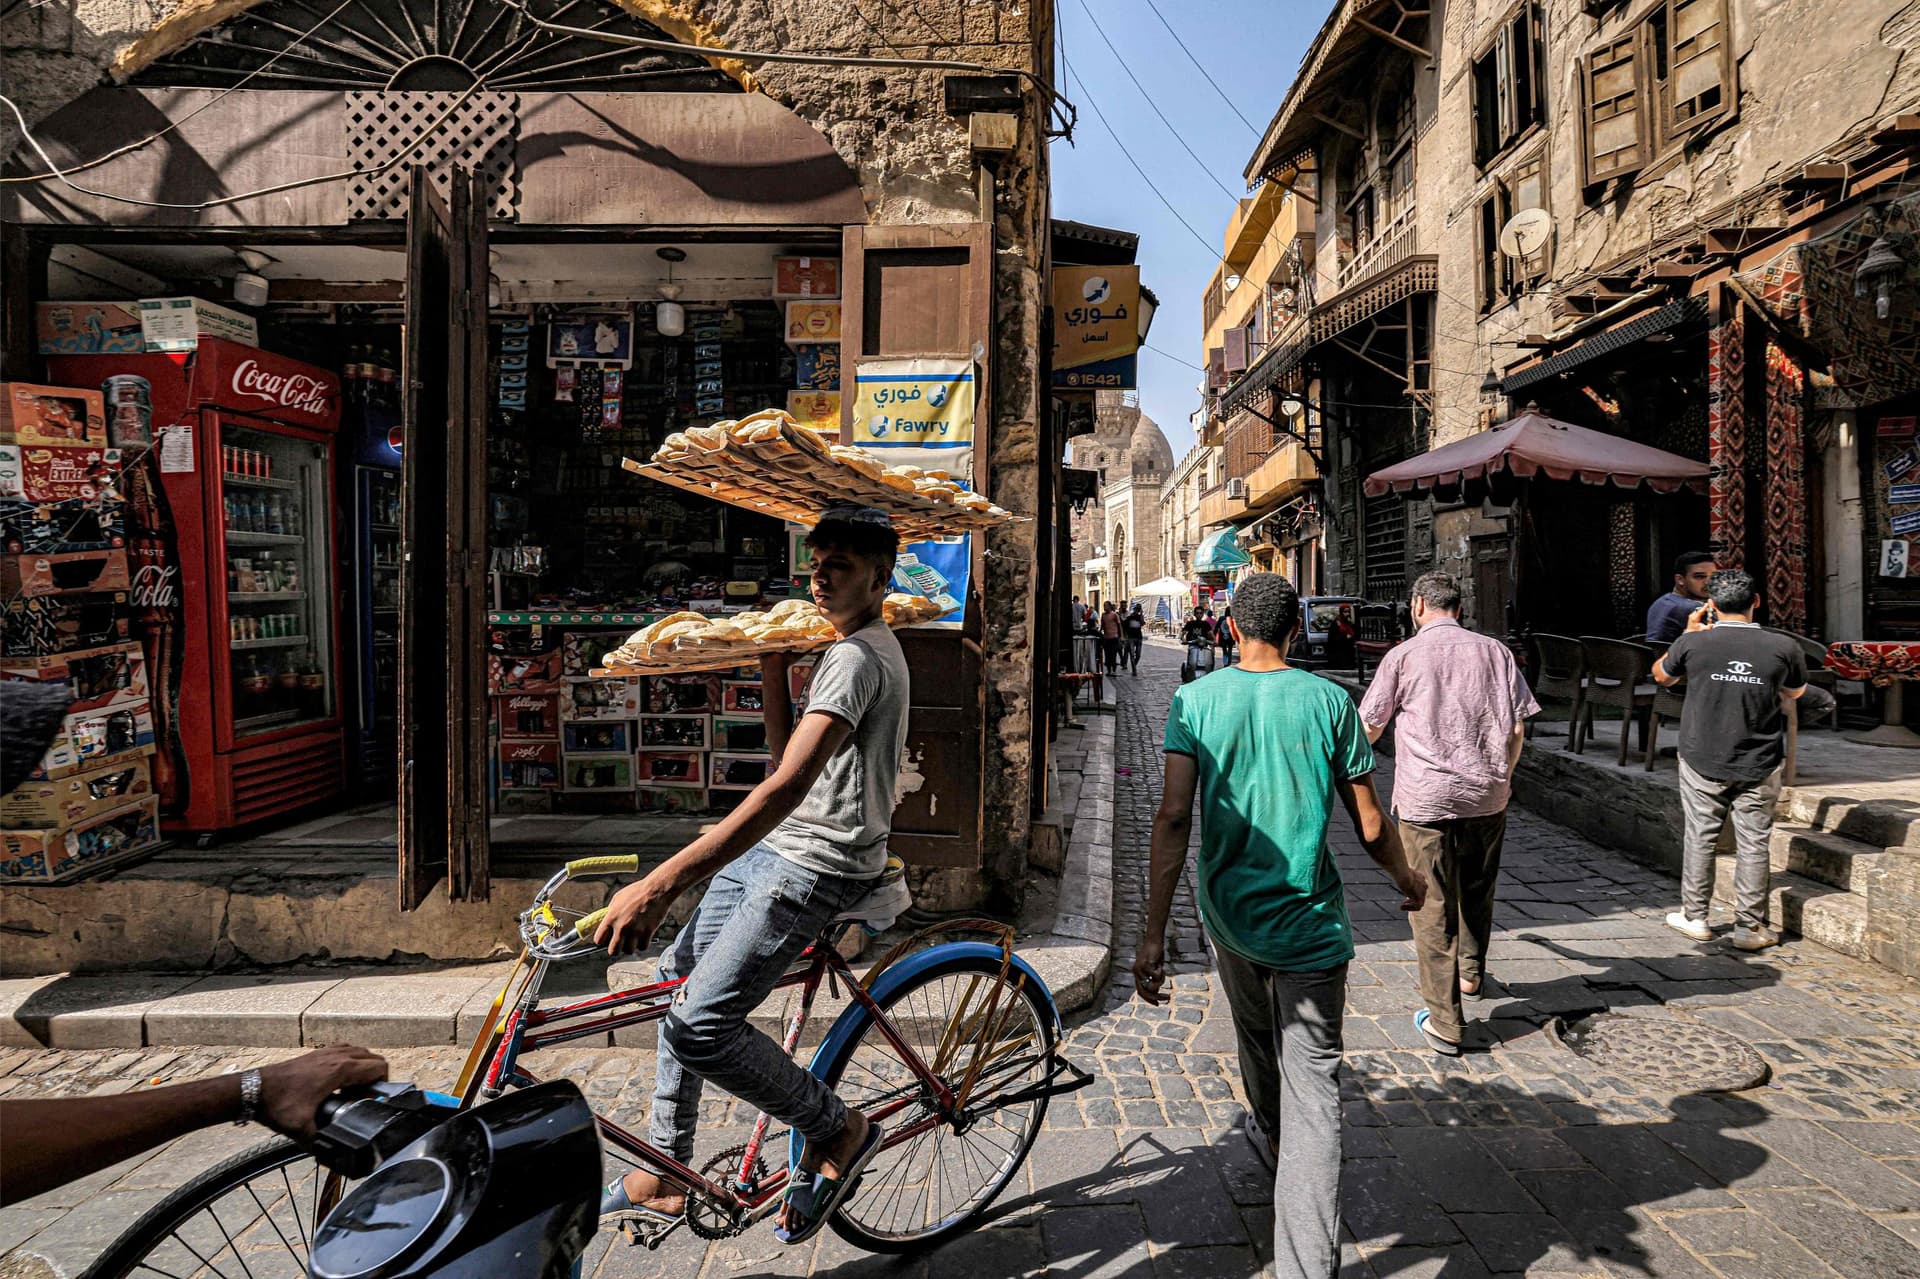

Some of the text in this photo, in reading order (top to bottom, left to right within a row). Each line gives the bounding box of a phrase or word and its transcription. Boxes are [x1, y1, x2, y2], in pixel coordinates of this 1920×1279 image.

[1064, 303, 1127, 326] فوري
[232, 359, 329, 414] Coca-Cola
[1080, 374, 1121, 385] 16421
[873, 384, 922, 408] فوري
[895, 418, 950, 435] fawry
[138, 548, 167, 557] TASTE
[128, 564, 178, 607] Cola
[1710, 673, 1765, 685] CHANEL
